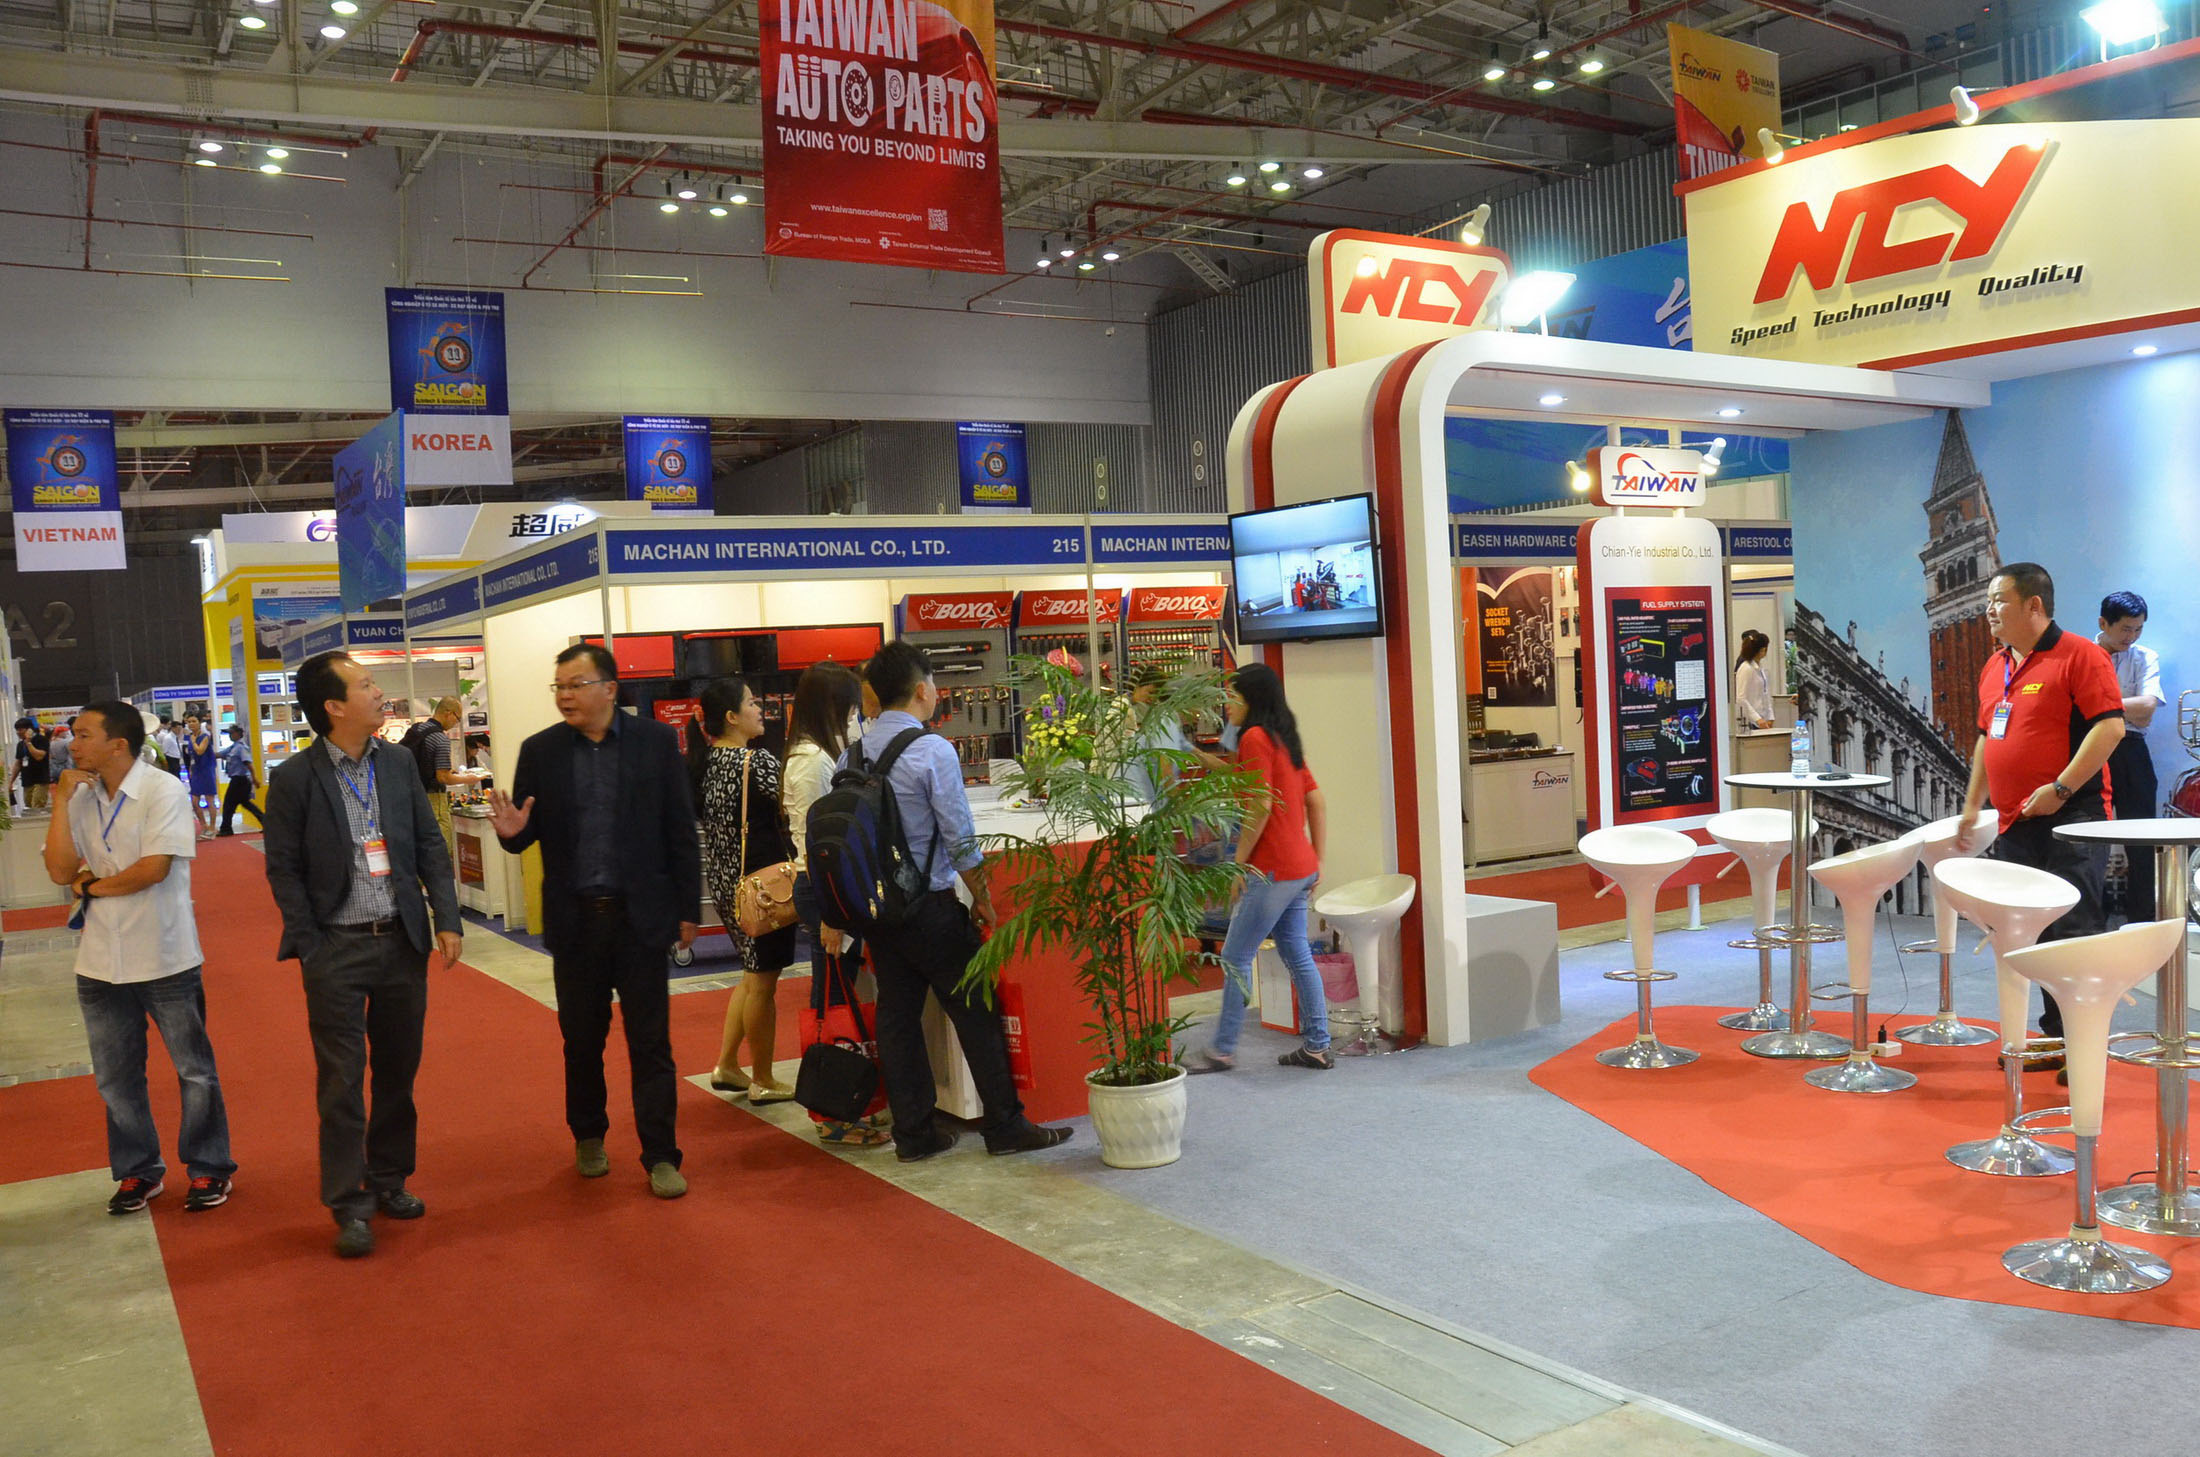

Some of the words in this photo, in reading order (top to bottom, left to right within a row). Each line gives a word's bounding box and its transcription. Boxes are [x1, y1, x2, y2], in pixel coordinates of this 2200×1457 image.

[780, 0, 918, 62] TAIWAN
[884, 68, 985, 143] PARTS
[776, 125, 834, 151] TAKING
[838, 135, 870, 155] YOU
[875, 138, 936, 163] BEYOND
[940, 147, 986, 170] LIMITS
[810, 203, 923, 222] www.taiwanexcellence.org/en
[1753, 139, 2049, 304] NCY
[1340, 258, 1498, 327] NCY
[1731, 316, 1797, 346] Speed
[1813, 289, 1952, 328] Technology
[1978, 264, 2084, 297] Quality
[414, 382, 487, 398] SAIGON
[412, 433, 494, 451] KOREA
[33, 484, 100, 498] SAIGON
[644, 484, 697, 497] SAIGON
[973, 484, 1017, 495] SAIGON
[1611, 474, 1697, 493] TAIWAN
[23, 527, 117, 542] VIETNAM
[1463, 534, 1502, 548] EASEN
[1504, 534, 1567, 548] HARDWARE
[1734, 535, 1784, 548] ARESTOOL
[623, 541, 709, 561] MACHAN
[715, 539, 866, 559] INTERNATIONAL
[870, 540, 907, 559] CO.,
[911, 538, 951, 556] LTD.
[1052, 538, 1080, 553] 215
[1101, 537, 1168, 552] MACHAN
[1601, 544, 1642, 559] Chian-Yie
[1643, 544, 1680, 558] Industrial
[1699, 544, 1715, 558] Ltd.
[936, 602, 993, 620] BOXO
[1155, 595, 1207, 612] BOXO
[1657, 600, 1680, 608] SUPPLY
[1680, 600, 1705, 608] SYSTEM
[1485, 607, 1509, 618] SOCKET
[1484, 617, 1511, 627] WRENCH
[353, 627, 386, 638] YUAN
